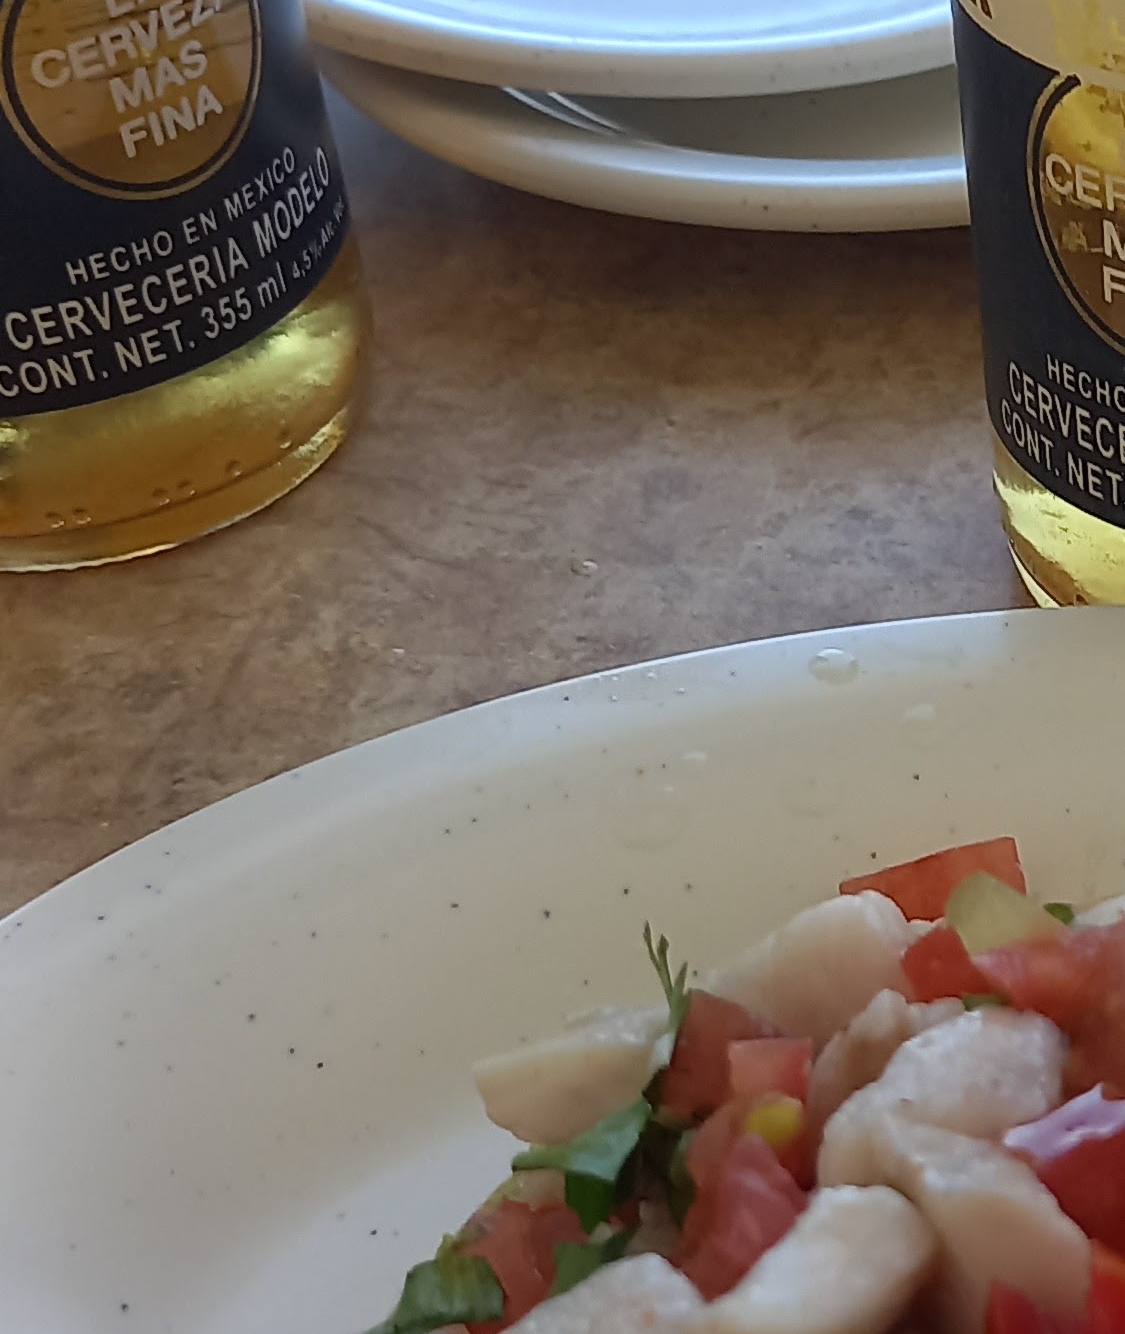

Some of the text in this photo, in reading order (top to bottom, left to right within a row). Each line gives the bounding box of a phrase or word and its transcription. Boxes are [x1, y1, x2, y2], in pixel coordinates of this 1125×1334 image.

[108, 39, 208, 114] MAS
[119, 84, 224, 159] FINA
[5, 146, 330, 352] CERVECERIA MODELO
[65, 230, 174, 286] HECHO
[182, 208, 219, 245] EN
[223, 146, 296, 222] MEXICO
[0, 348, 109, 398] CONT.
[114, 319, 196, 373] NET.
[201, 286, 252, 340] 355
[257, 261, 287, 309] ml
[1002, 397, 1061, 478] CONT.
